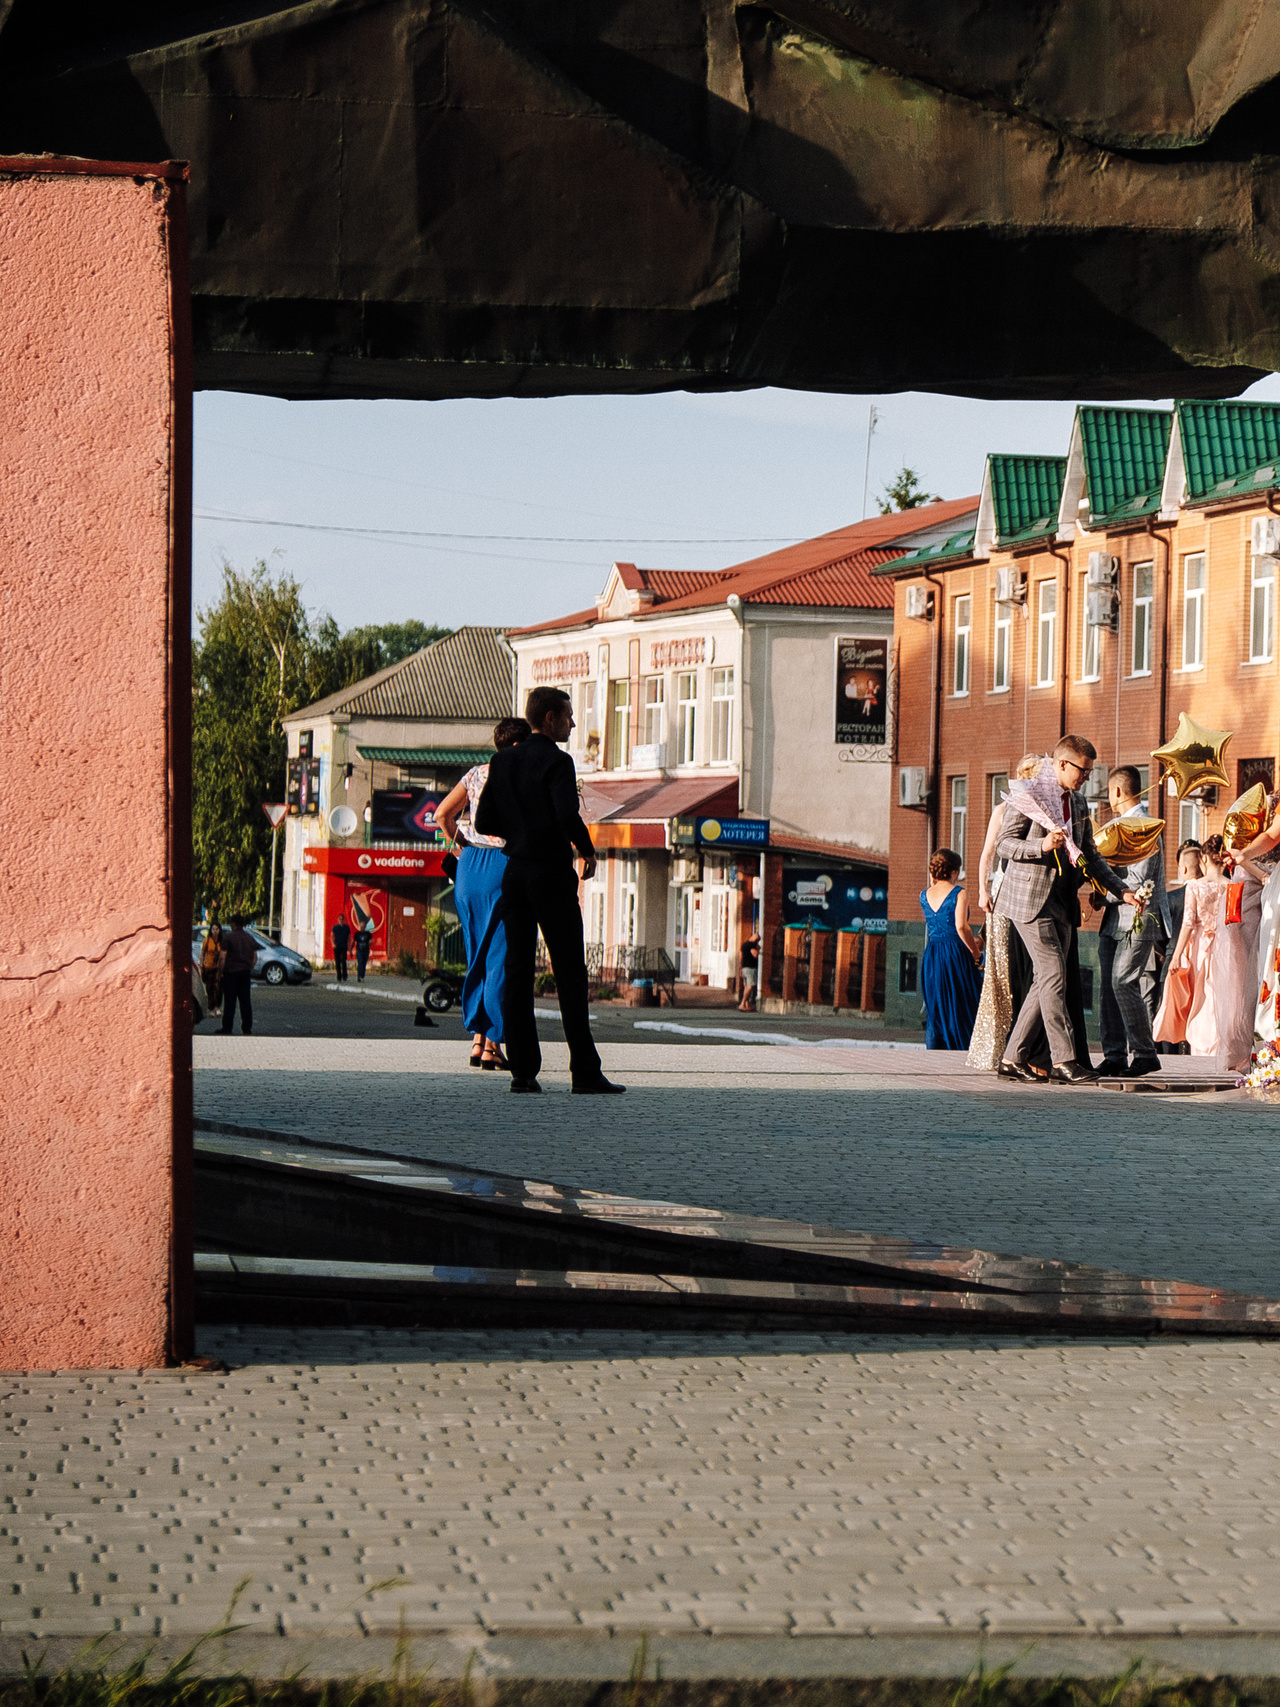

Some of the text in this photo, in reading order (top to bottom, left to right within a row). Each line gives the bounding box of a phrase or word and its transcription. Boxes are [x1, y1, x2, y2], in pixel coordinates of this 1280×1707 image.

[837, 723, 885, 733] РЕСТОРАН
[837, 734, 884, 743] ГОТЕЛЬ
[721, 829, 765, 840] ЛОТЕРЕЯ
[374, 856, 425, 868] vodafone
